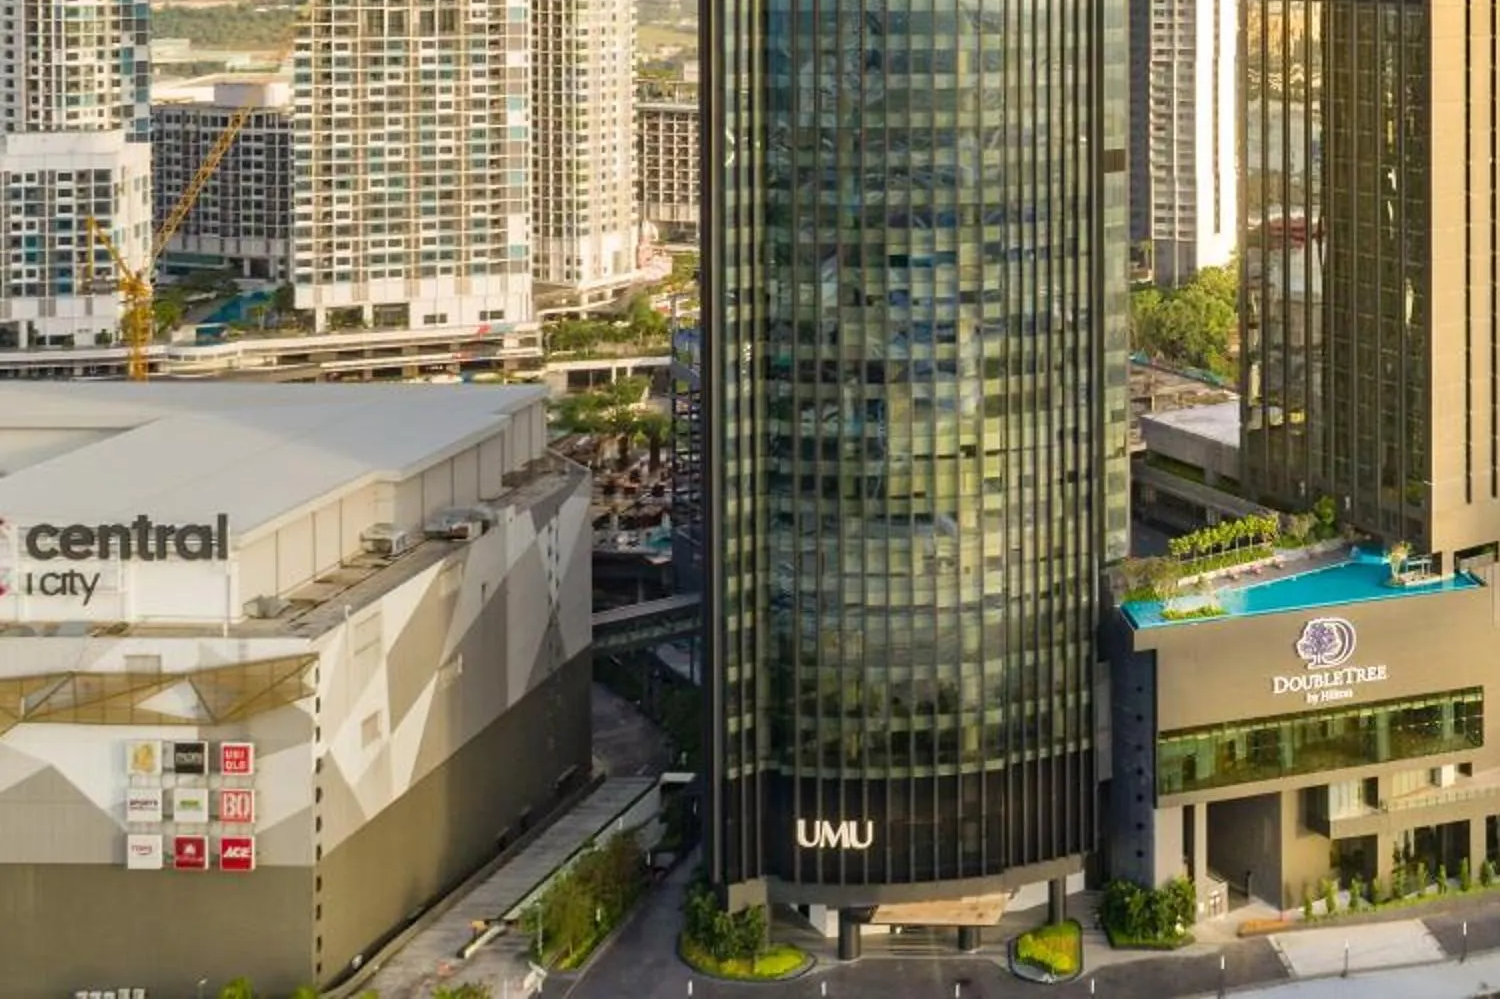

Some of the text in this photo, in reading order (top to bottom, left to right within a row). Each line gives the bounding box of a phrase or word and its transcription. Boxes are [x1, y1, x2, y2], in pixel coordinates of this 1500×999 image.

[26, 513, 229, 561] central
[40, 569, 101, 606] city
[1306, 691, 1319, 706] by
[797, 819, 873, 849] UMU
[223, 846, 252, 858] ACE
